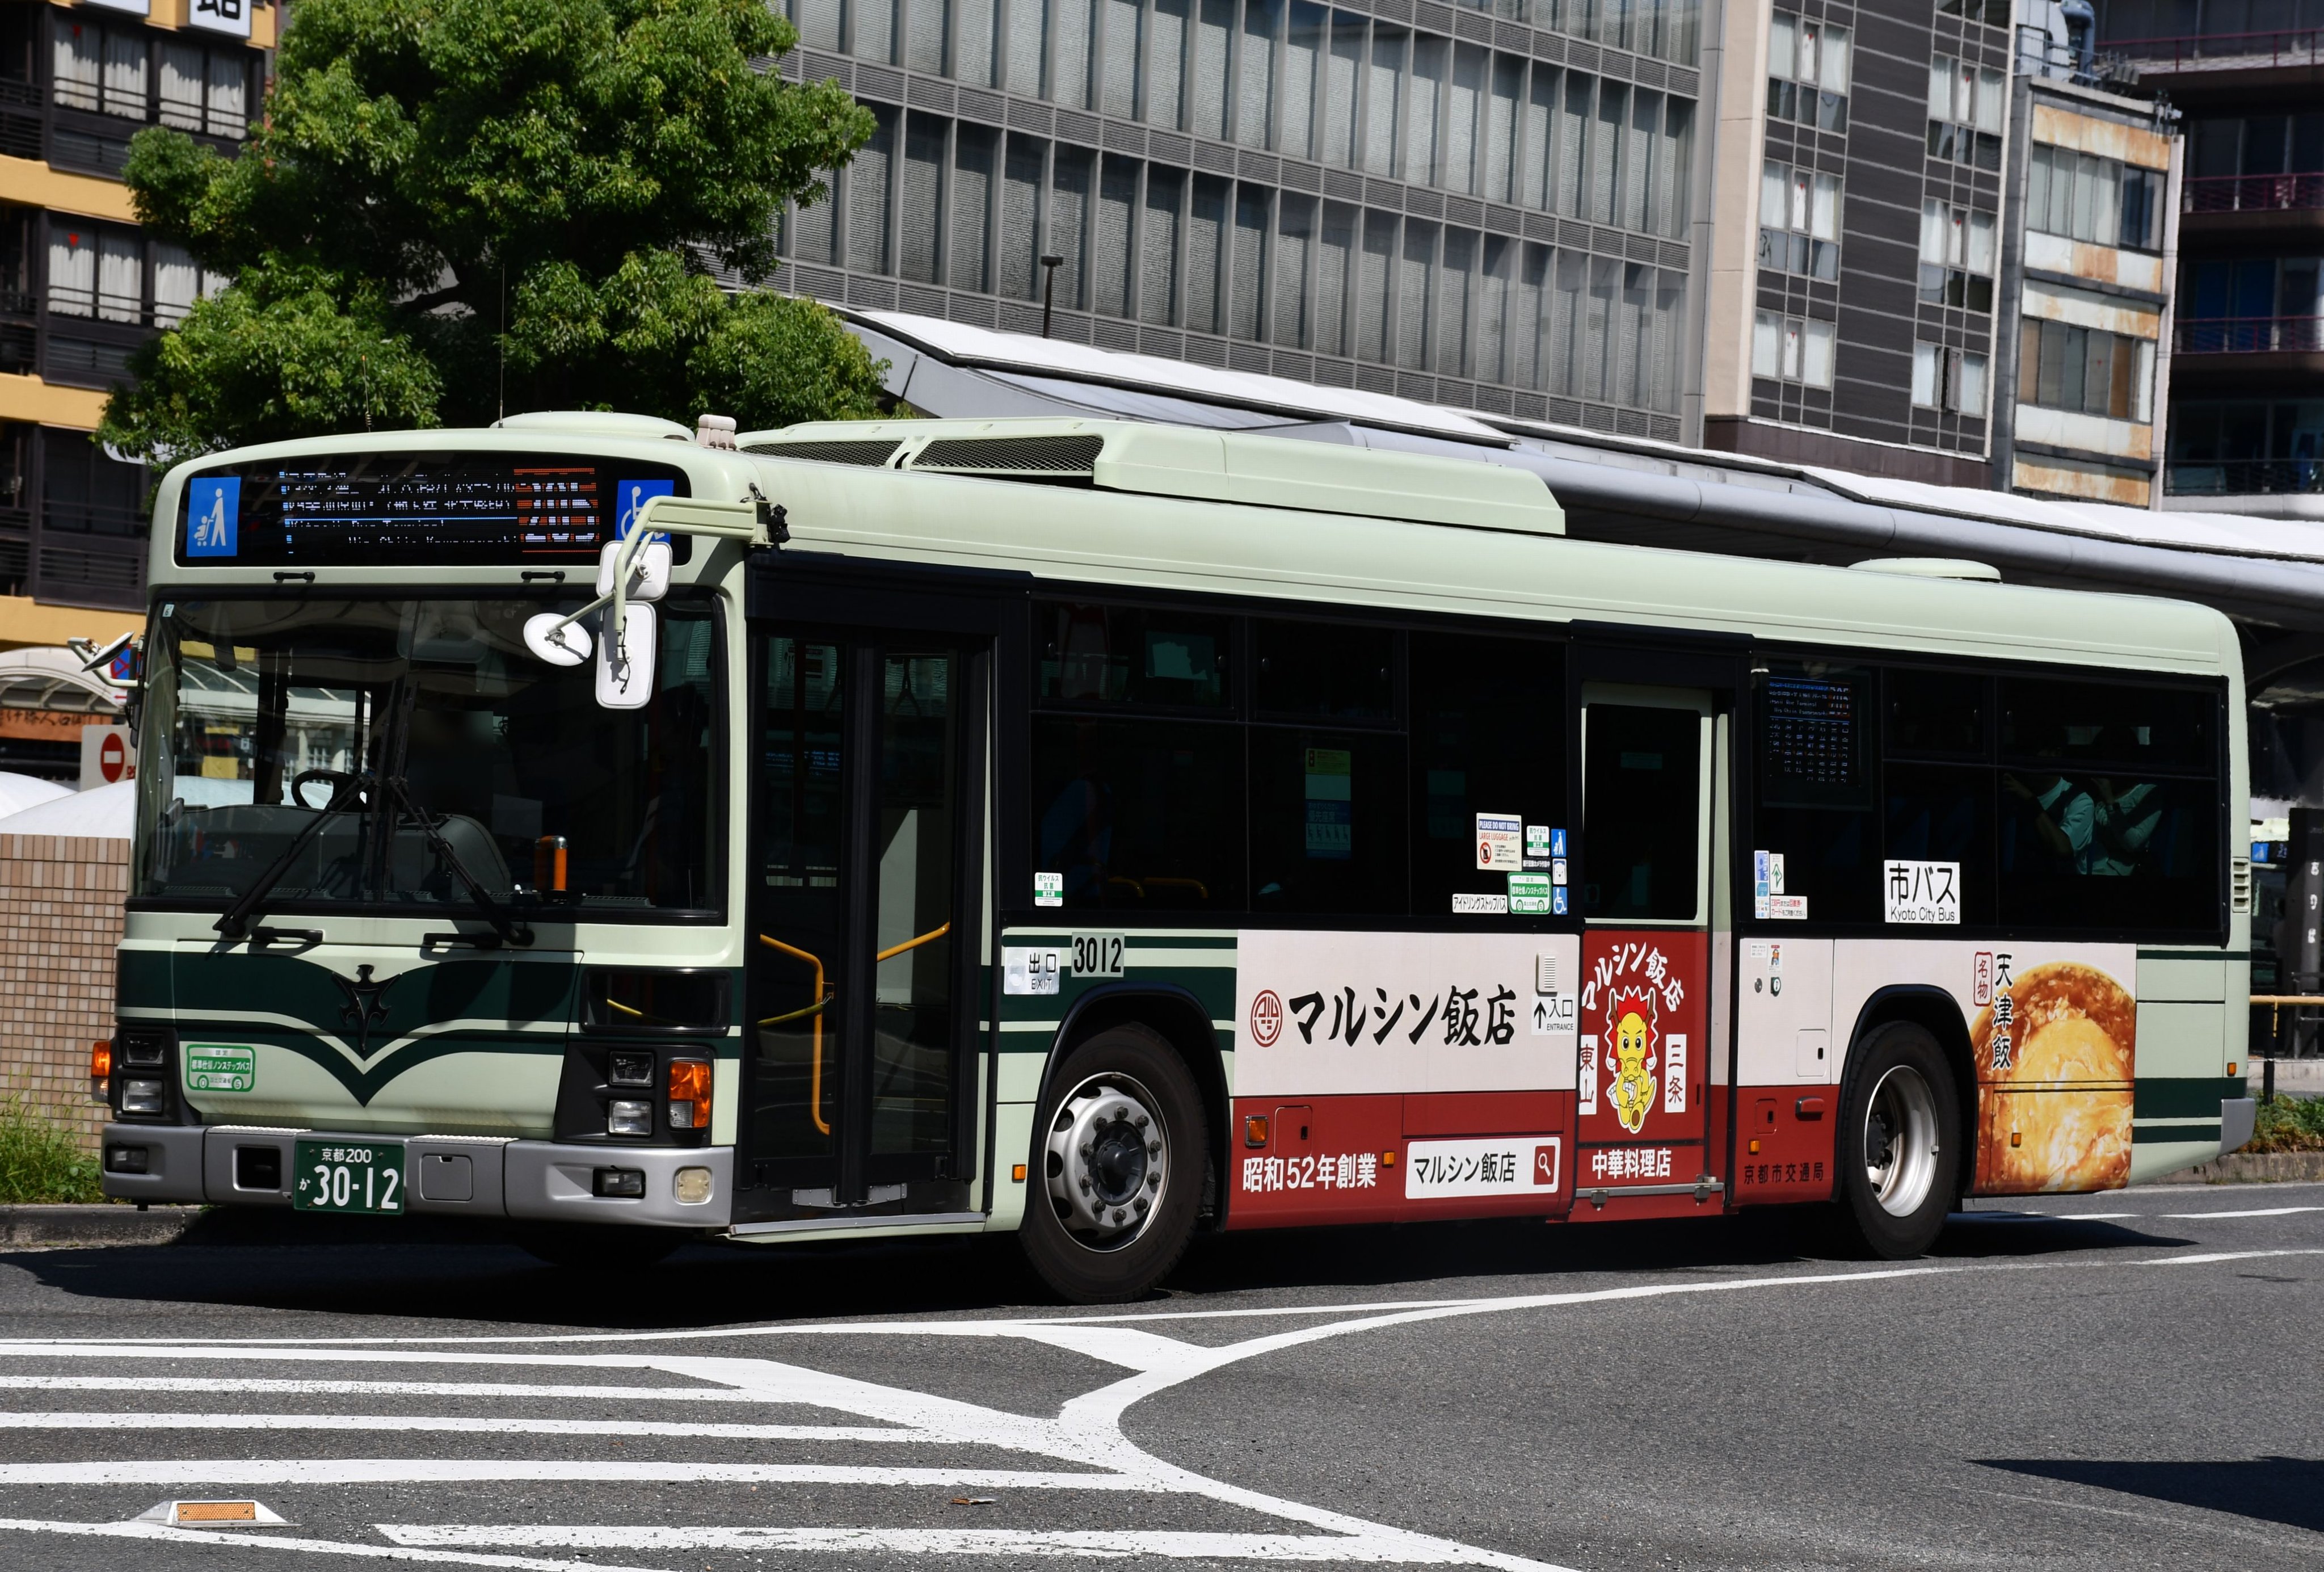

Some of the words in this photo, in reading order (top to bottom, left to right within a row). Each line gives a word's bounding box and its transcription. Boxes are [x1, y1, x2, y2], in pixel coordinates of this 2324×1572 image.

[1507, 822, 1519, 831] BRING
[1889, 862, 1956, 906] 市バス
[1454, 897, 1506, 910] アイドリングストップバス
[1891, 906, 1917, 922] Kyoto
[1919, 906, 1935, 923] City
[1938, 907, 1955, 921] Bus
[1029, 952, 1056, 973] 出口
[1073, 937, 1122, 973] 3012
[1031, 978, 1052, 990] EXIT
[1581, 941, 1684, 1012] マルシン飯店
[1977, 959, 1988, 999] 名物
[1289, 984, 1517, 1047] マルシン飯店
[1548, 998, 1573, 1018] 入口
[1993, 953, 2013, 1069] 天津飯
[192, 1059, 250, 1071] 標準仕様ノンステップバス
[1579, 1044, 1595, 1104] 東山
[1668, 1044, 1684, 1104] 三条
[1243, 1153, 1376, 1193] 昭和52年創業
[1414, 1151, 1517, 1185] マルシン飯店
[1592, 1148, 1672, 1180] 中華料理店
[1744, 1162, 1824, 1185] 京都市交通局
[299, 1178, 311, 1191] か
[313, 1165, 399, 1210] 30-12
